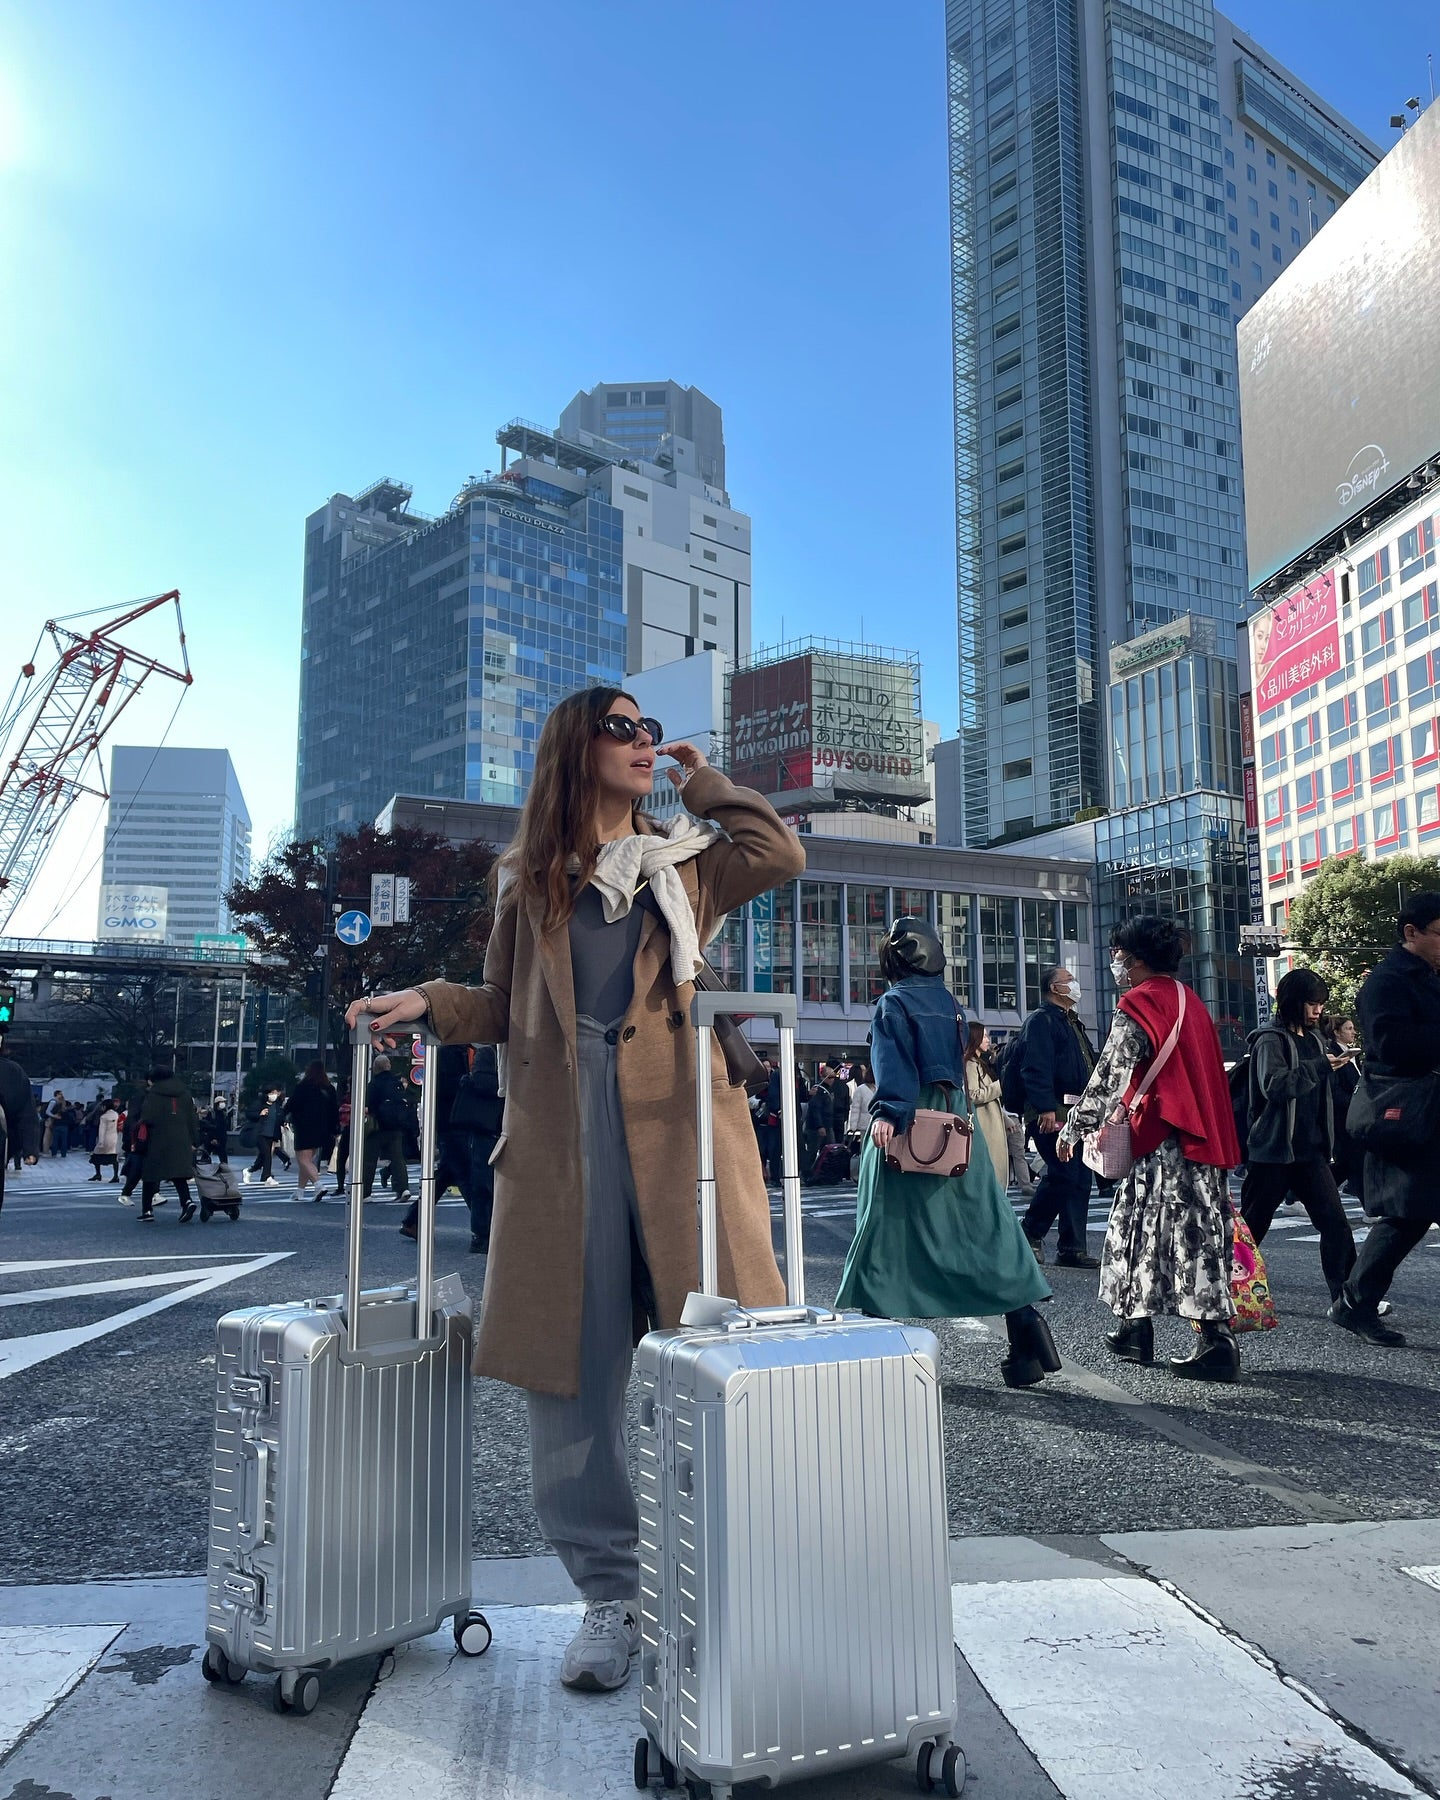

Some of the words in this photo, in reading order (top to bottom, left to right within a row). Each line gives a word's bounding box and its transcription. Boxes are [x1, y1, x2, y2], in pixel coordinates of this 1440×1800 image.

[415, 506, 465, 541] FUKURAS
[498, 507, 531, 524] TOKYU
[533, 518, 566, 535] PLAZA
[1288, 585, 1331, 622] 品川スキン
[1289, 604, 1327, 640] クリニック
[1267, 643, 1335, 699] 品川美容外科
[817, 681, 891, 706] ココロの
[735, 700, 808, 743] カラオケ
[816, 727, 912, 753] あげていこう。
[814, 747, 912, 776] JOYSOUND
[1105, 854, 1151, 872] MARK
[1248, 842, 1261, 894] 加藤眼科
[104, 894, 159, 904] すべての人に
[104, 904, 158, 913] インターネット
[380, 878, 391, 922] 渋谷駅前
[104, 917, 157, 929] GMO
[1252, 914, 1262, 922] 3F
[1255, 958, 1268, 1027] 産婦人科・心療内
